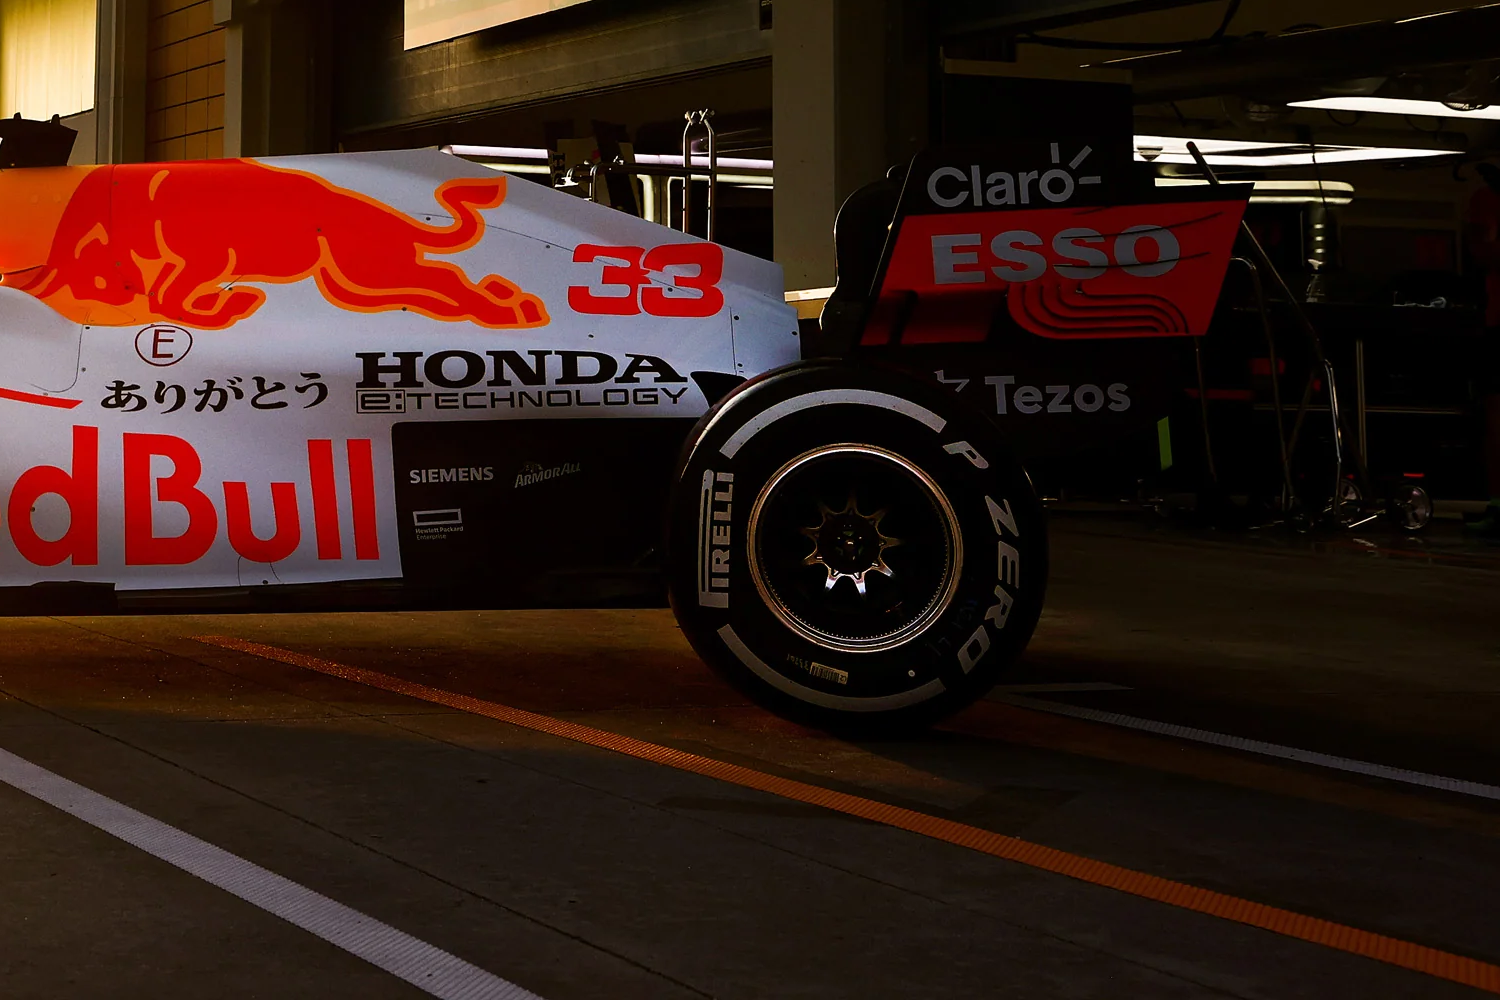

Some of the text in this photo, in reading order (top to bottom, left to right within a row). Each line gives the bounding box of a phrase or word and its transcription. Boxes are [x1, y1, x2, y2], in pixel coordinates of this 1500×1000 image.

[927, 165, 1074, 207] Claro
[931, 225, 1180, 285] ESSO
[568, 242, 724, 317] 33
[152, 329, 175, 359] E
[355, 350, 688, 388] HONDA
[101, 373, 328, 414] ありがとう
[984, 375, 1131, 415] Tezos
[409, 466, 494, 484] SIEMENS
[123, 432, 380, 565] Bull
[699, 469, 735, 609] PIRELLI
[943, 440, 1020, 675] P ZERO
